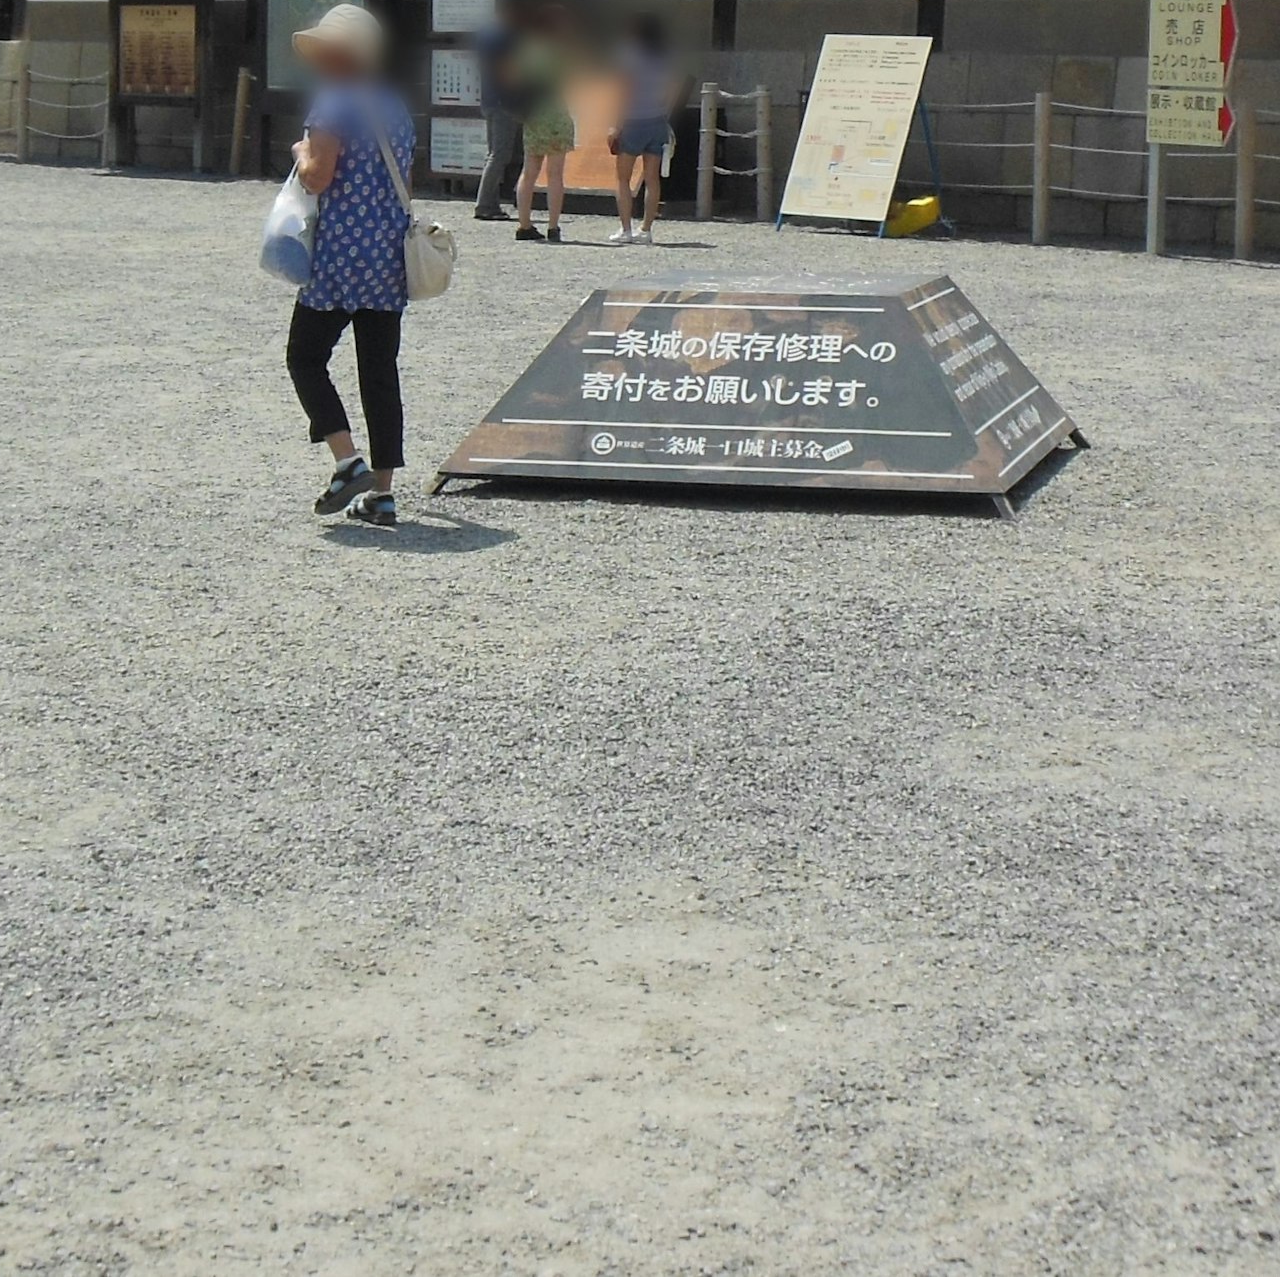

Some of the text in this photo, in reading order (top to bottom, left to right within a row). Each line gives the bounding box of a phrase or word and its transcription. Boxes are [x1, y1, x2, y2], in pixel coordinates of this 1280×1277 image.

[1159, 2, 1214, 13] LOUNGE
[1166, 18, 1206, 35] 売店
[1166, 35, 1201, 46] SHOP
[1152, 53, 1217, 69] コインロッカー
[582, 328, 897, 364] 二条城の保存修理への
[580, 371, 880, 407] 寄付をお願いします。
